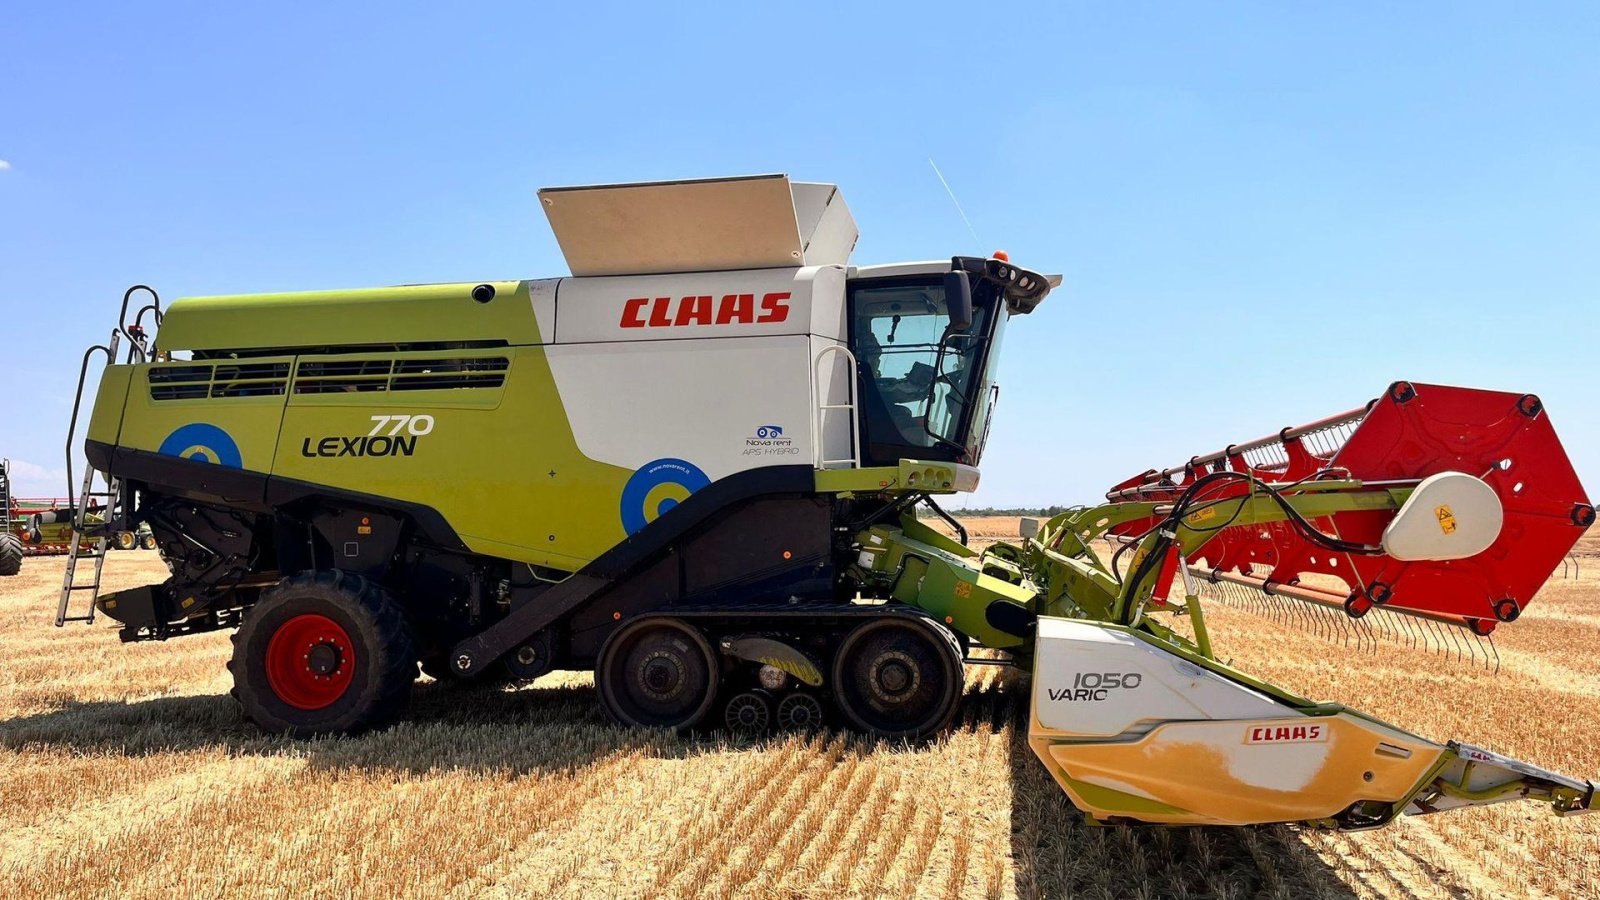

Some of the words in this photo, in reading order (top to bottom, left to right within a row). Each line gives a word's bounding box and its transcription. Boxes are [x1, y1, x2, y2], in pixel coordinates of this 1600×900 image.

[619, 292, 791, 328] CLAAS
[367, 415, 434, 436] 770
[302, 436, 417, 457] LEXION
[1073, 673, 1142, 689] 1050
[1252, 726, 1321, 741] CLAAS
